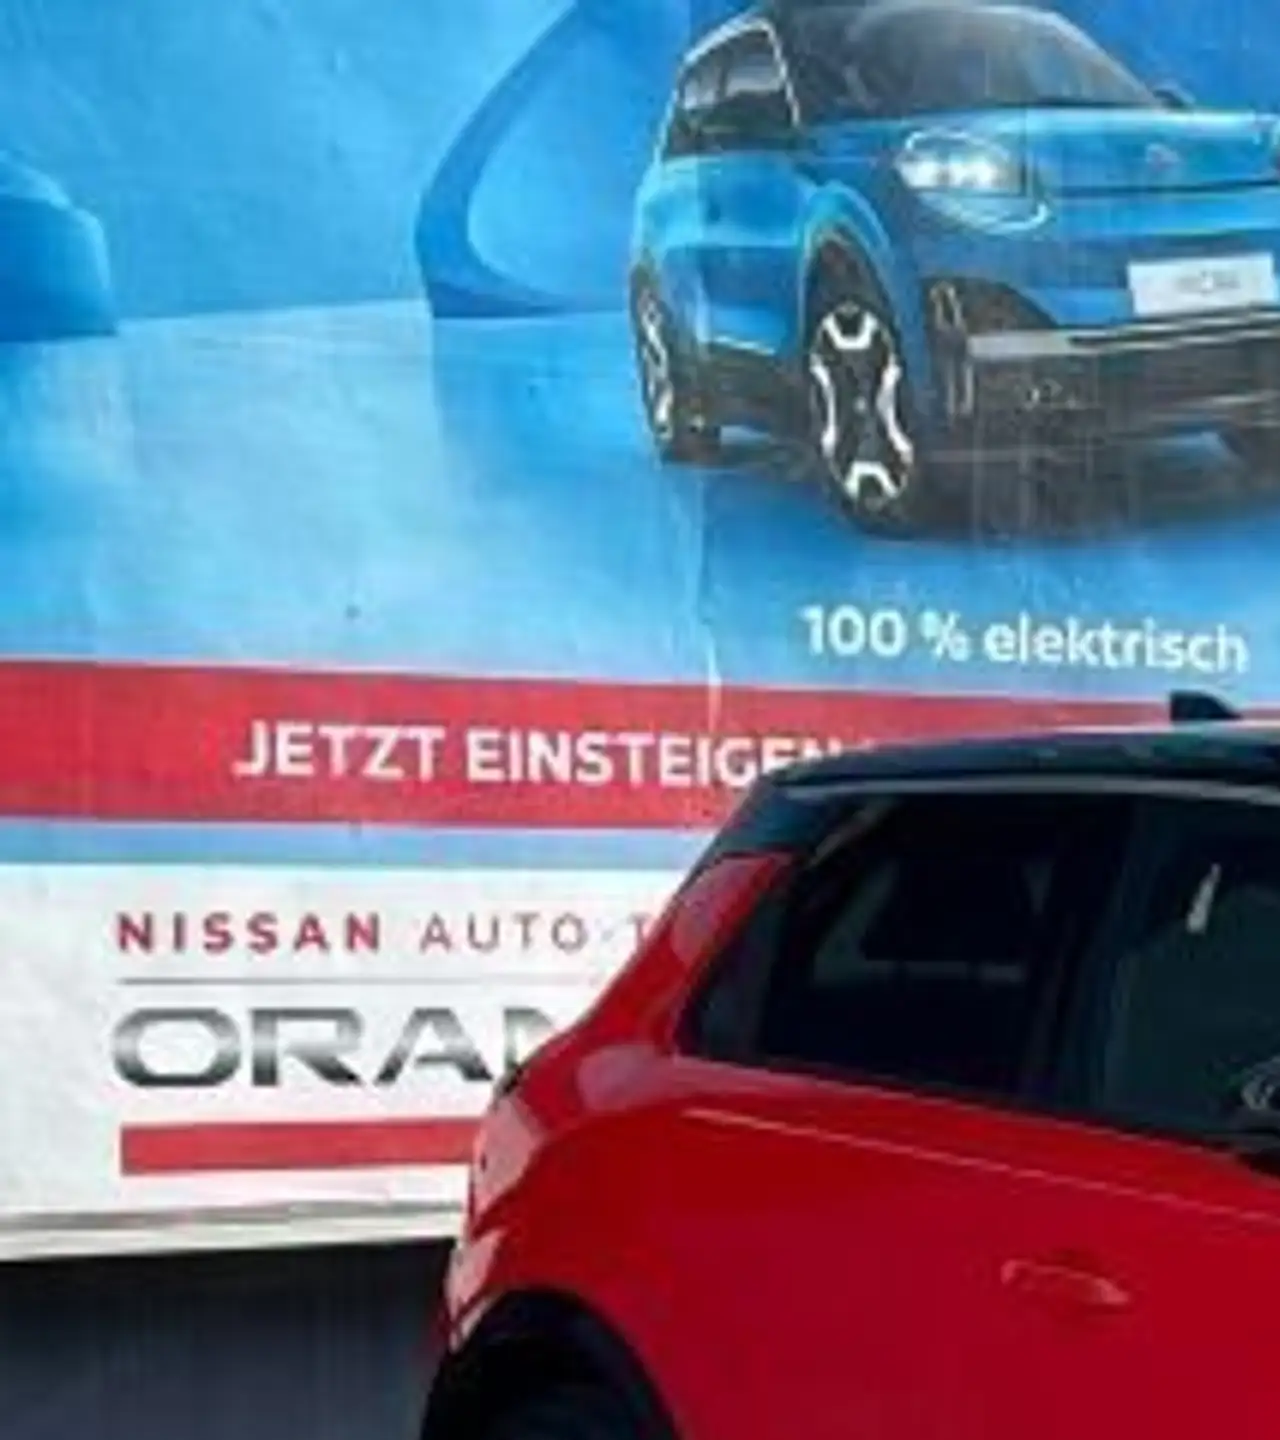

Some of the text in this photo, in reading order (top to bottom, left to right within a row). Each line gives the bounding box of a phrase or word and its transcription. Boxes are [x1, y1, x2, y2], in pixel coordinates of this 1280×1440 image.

[803, 604, 1249, 673] 100 % elektrisch
[231, 719, 446, 783] JETZT
[116, 911, 380, 953] NISSAN
